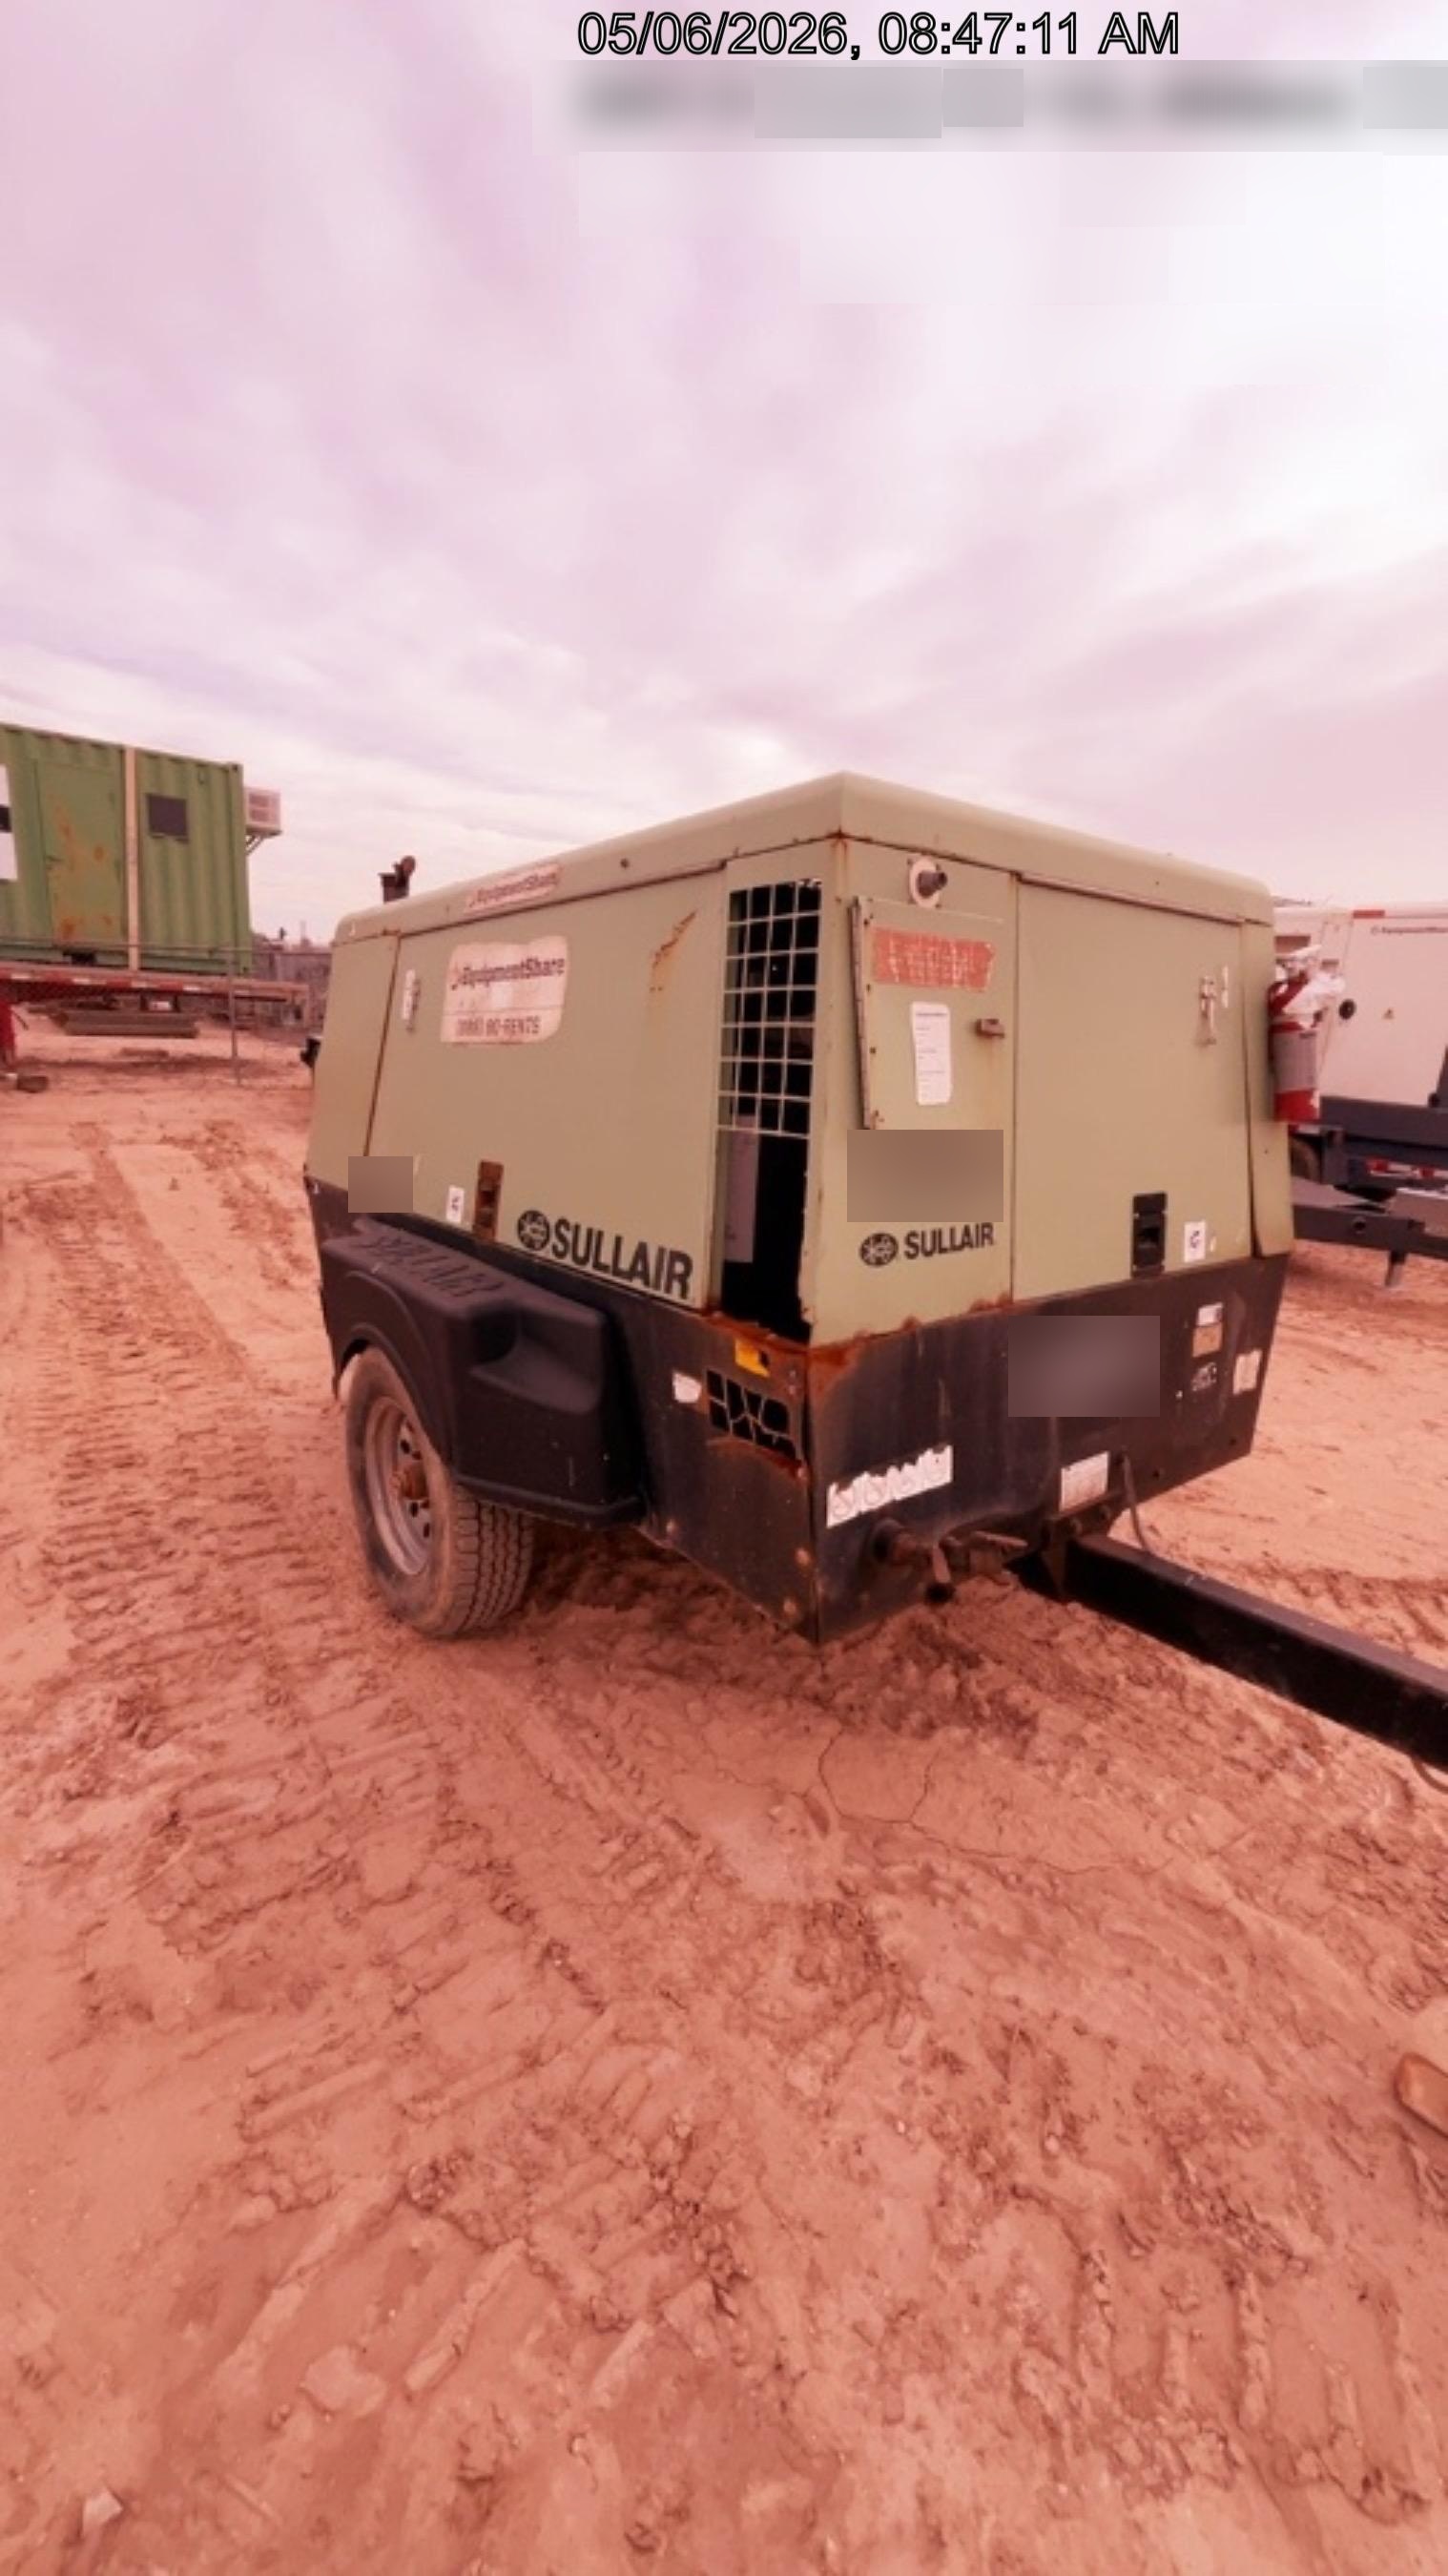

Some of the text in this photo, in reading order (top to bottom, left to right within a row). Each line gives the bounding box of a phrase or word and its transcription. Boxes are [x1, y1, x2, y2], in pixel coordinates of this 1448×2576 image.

[458, 957, 565, 988] EquipmentShare
[552, 1217, 693, 1300] SULLAIR
[903, 1221, 994, 1260] SULLAIR
